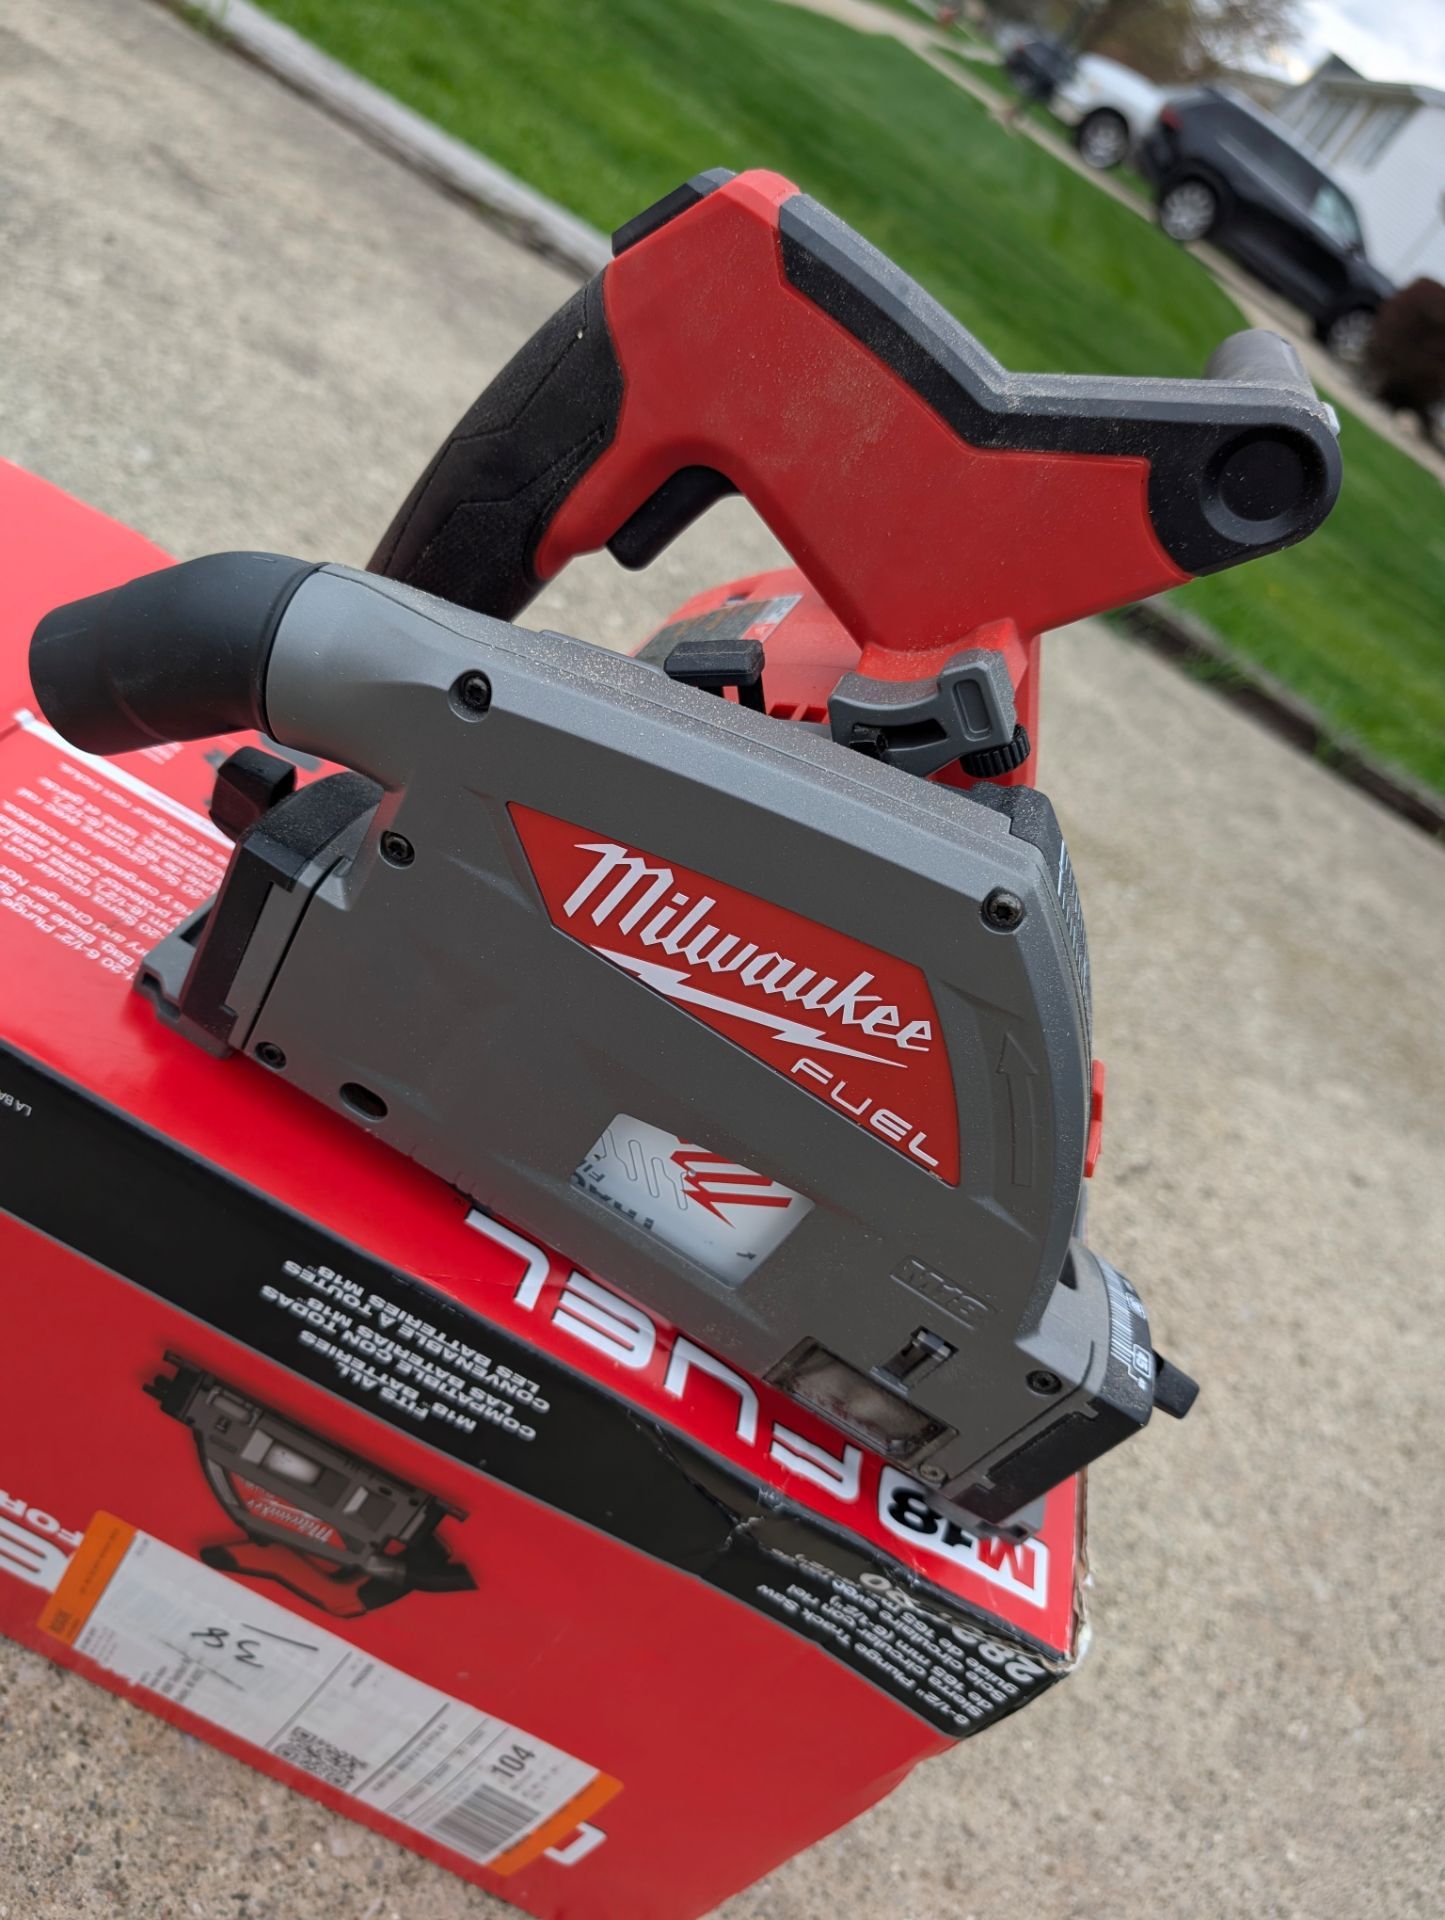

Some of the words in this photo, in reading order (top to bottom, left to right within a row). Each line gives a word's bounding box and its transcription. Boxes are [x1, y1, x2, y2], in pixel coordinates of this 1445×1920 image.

[40, 801, 82, 826] avec
[130, 804, 199, 846] chargeur
[1, 842, 34, 862] con
[9, 833, 50, 858] para
[47, 844, 101, 877] contra
[68, 841, 92, 855] no
[78, 824, 148, 866] circulaire
[33, 861, 92, 897] circular
[46, 856, 93, 885] bolsa
[88, 852, 163, 896] cargador
[144, 863, 182, 885] Scie
[0, 895, 58, 932] Plunge
[14, 893, 50, 914] and
[29, 883, 97, 924] Charger
[87, 894, 139, 926] Sierra
[100, 875, 171, 917] protector
[47, 912, 97, 943] Blade
[91, 922, 127, 944] and
[562, 842, 936, 1055] Milwaukee
[15, 1099, 33, 1117] LA
[791, 1057, 939, 1167] FUEL
[282, 1258, 375, 1317] TOUTES
[260, 1283, 340, 1334] TODAS
[341, 1328, 394, 1363] CON
[367, 1292, 492, 1367] BATTERIES
[298, 1328, 419, 1401] BATTERIES
[396, 1321, 551, 1414] CONVENABLE
[465, 1208, 862, 1503] FUEL
[332, 1360, 378, 1393] ALL
[495, 1363, 540, 1393] LES
[378, 1385, 429, 1421] FITS
[395, 1355, 537, 1442] COMPATIBLE
[467, 1384, 514, 1416] LAS
[755, 1581, 800, 1611] Saw
[785, 1583, 819, 1607] riel
[828, 1577, 879, 1612] avec
[799, 1607, 853, 1644] Track
[821, 1602, 856, 1626] con
[901, 1612, 936, 1636] 165
[854, 1626, 927, 1675] circular
[875, 1610, 964, 1670] circulaire
[895, 1640, 931, 1665] mm
[936, 1637, 964, 1656] de
[850, 1641, 919, 1687] Plunge
[930, 1666, 965, 1690] 165
[963, 1656, 1019, 1694] guide
[925, 1676, 985, 1717] Sierra
[963, 1671, 1007, 1701] Scie
[965, 1691, 994, 1710] de
[915, 1687, 970, 1725] 6-1/2"
[490, 1743, 537, 1784] 104
